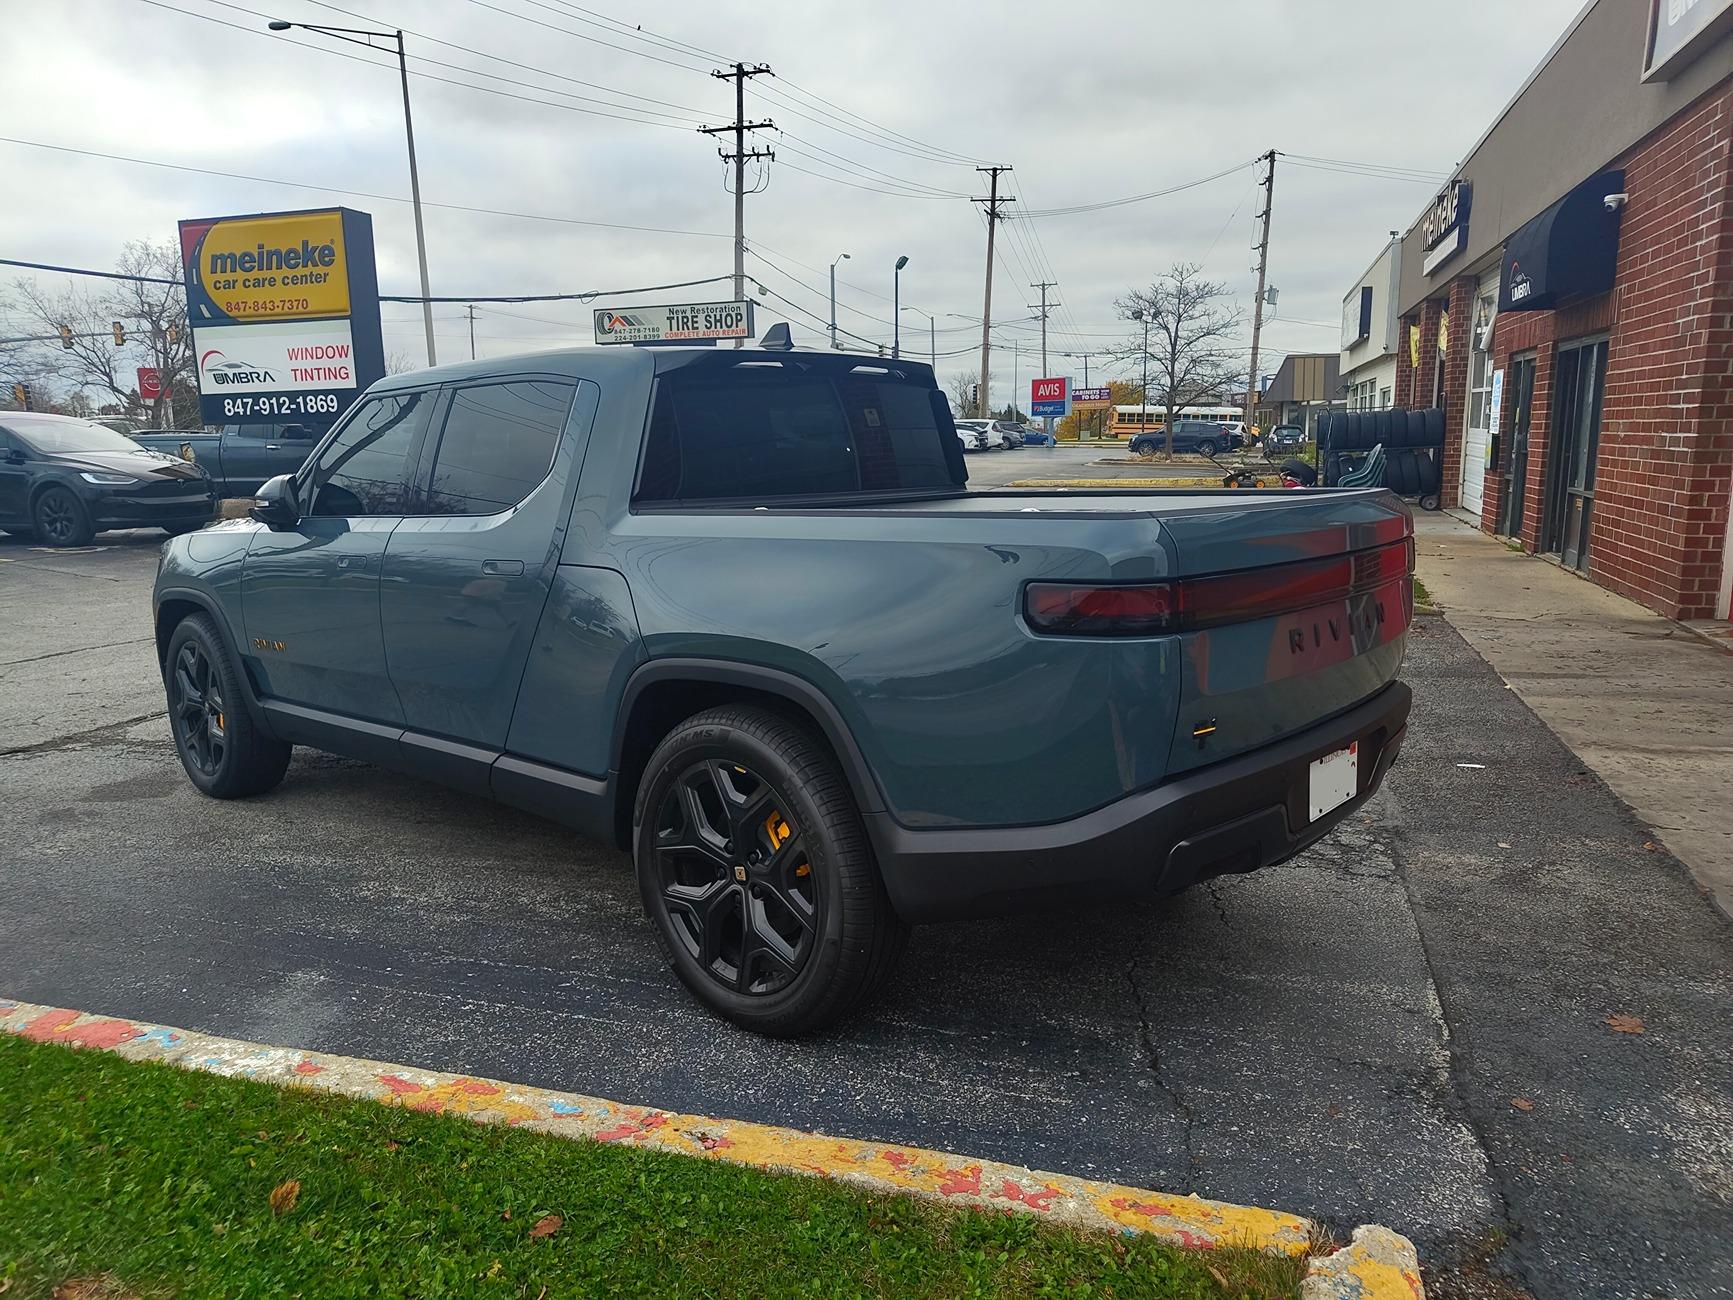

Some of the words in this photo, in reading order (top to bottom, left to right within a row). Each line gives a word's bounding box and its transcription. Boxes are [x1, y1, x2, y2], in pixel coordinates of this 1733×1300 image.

[1422, 182, 1459, 252] meineke
[210, 239, 336, 274] meineke
[213, 278, 238, 290] car
[242, 276, 277, 289] care
[281, 271, 329, 285] center
[668, 307, 688, 316] New
[690, 305, 741, 315] Restoration
[666, 315, 699, 331] TIRE
[704, 312, 743, 330] SHOP
[664, 330, 699, 339] COMPLETE
[702, 329, 720, 337] AUTO
[722, 328, 747, 336] REPAIR
[287, 344, 350, 361] WINDOW
[212, 371, 276, 385] UMBRA
[291, 366, 350, 382] TINTING
[1038, 383, 1060, 396] AVIS
[224, 394, 338, 417] 847-912-1869
[1288, 602, 1385, 654] RIVIAN
